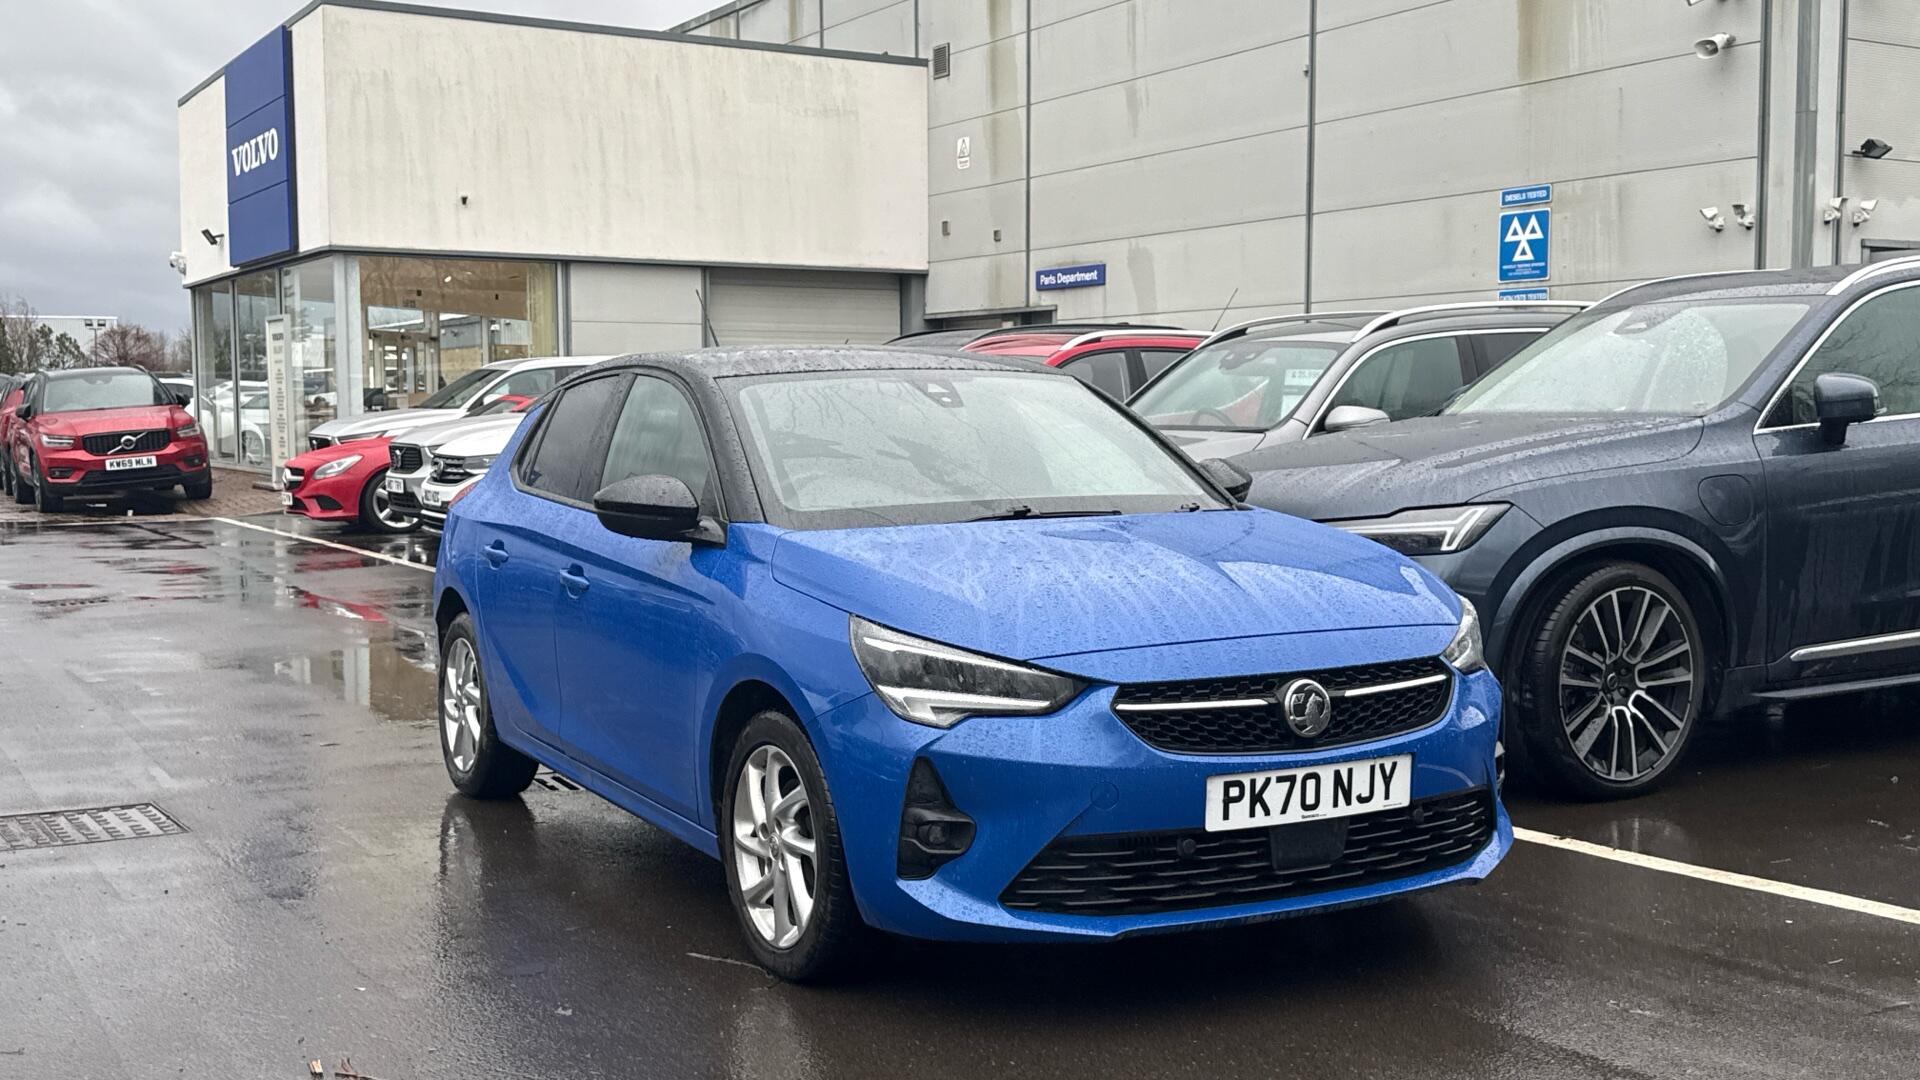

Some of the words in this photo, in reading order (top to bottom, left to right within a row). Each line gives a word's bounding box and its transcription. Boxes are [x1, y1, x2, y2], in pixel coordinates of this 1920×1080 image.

[232, 128, 278, 176] VOLVO
[1504, 192, 1526, 202] DIESELS
[1526, 190, 1547, 199] TESTED
[1040, 274, 1056, 285] Parts
[1057, 270, 1098, 284] Department
[110, 459, 132, 468] KW69
[1222, 771, 1321, 821] PK70
[1332, 761, 1398, 808] NJY
